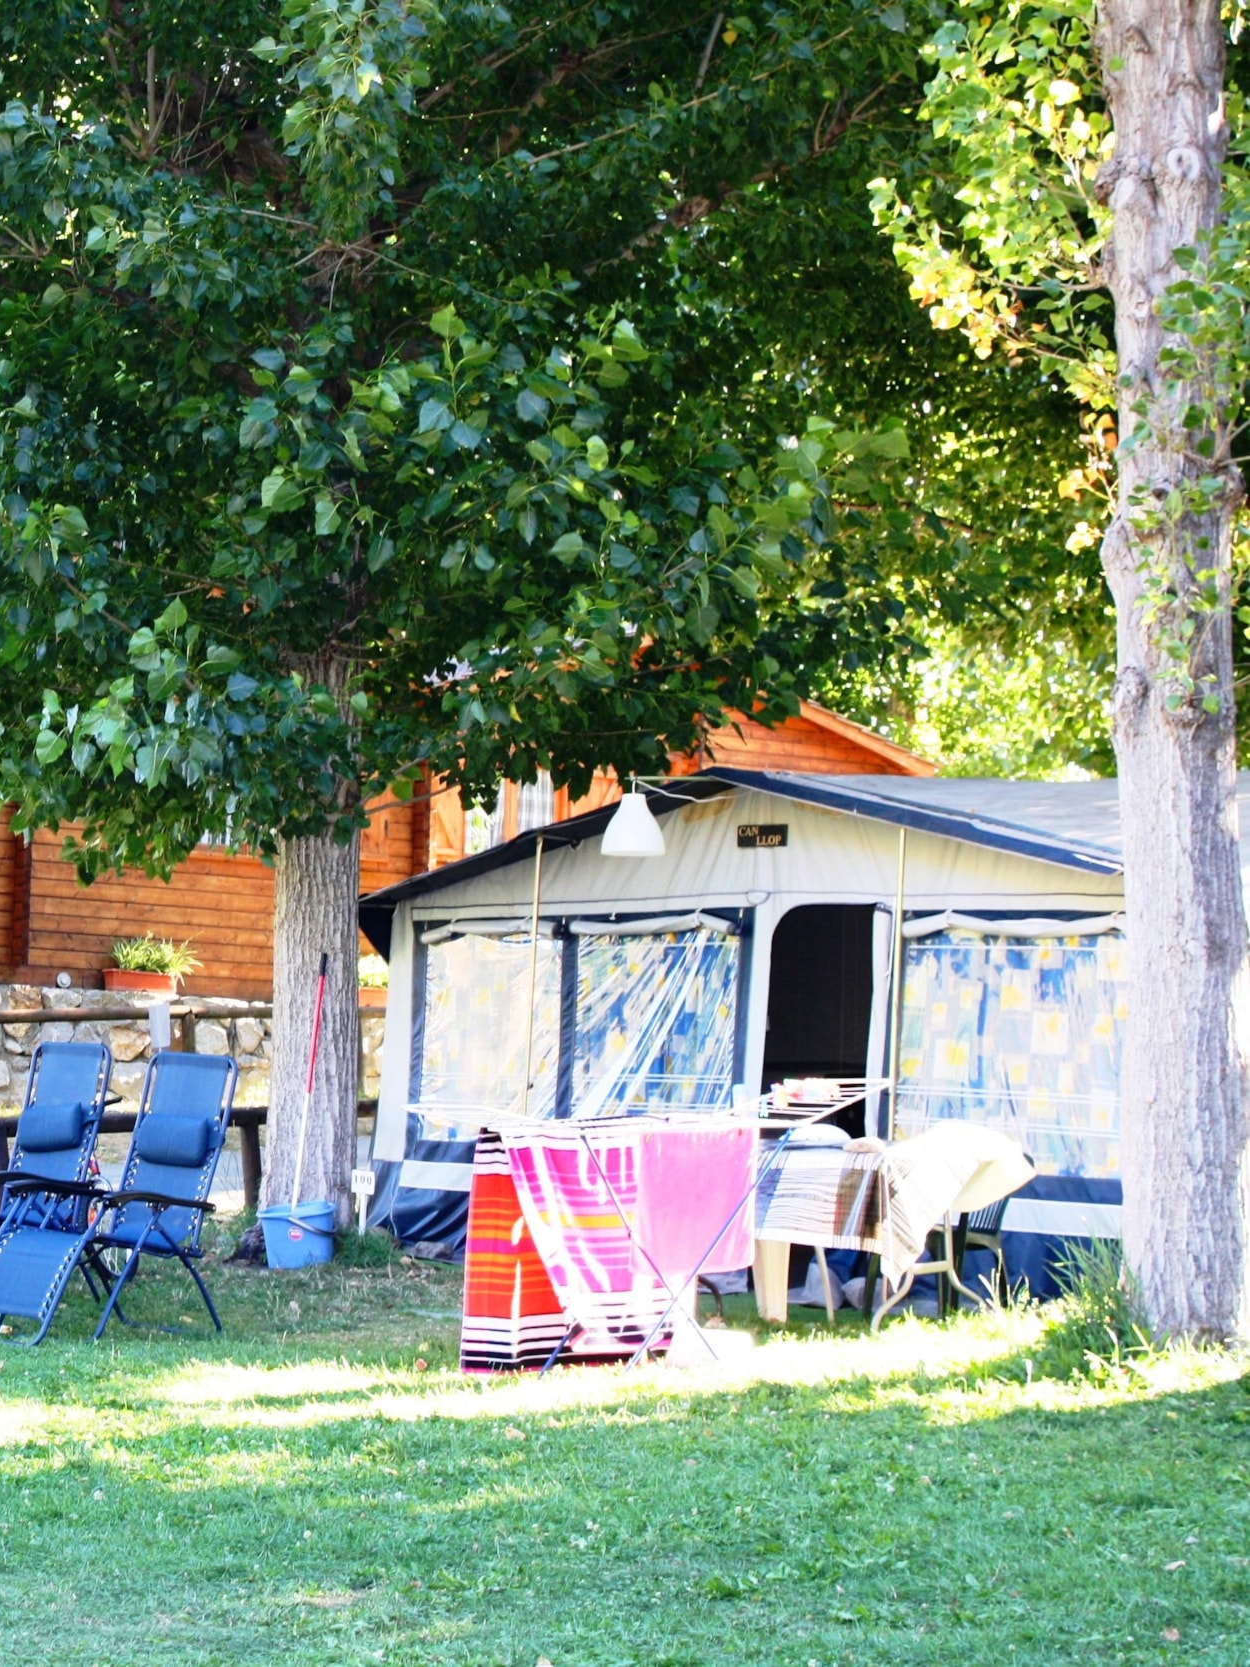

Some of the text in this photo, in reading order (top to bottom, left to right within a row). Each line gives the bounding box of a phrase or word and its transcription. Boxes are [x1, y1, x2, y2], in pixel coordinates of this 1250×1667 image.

[738, 826, 759, 837] CAN
[756, 835, 782, 846] LLOP
[354, 1174, 372, 1185] 100
